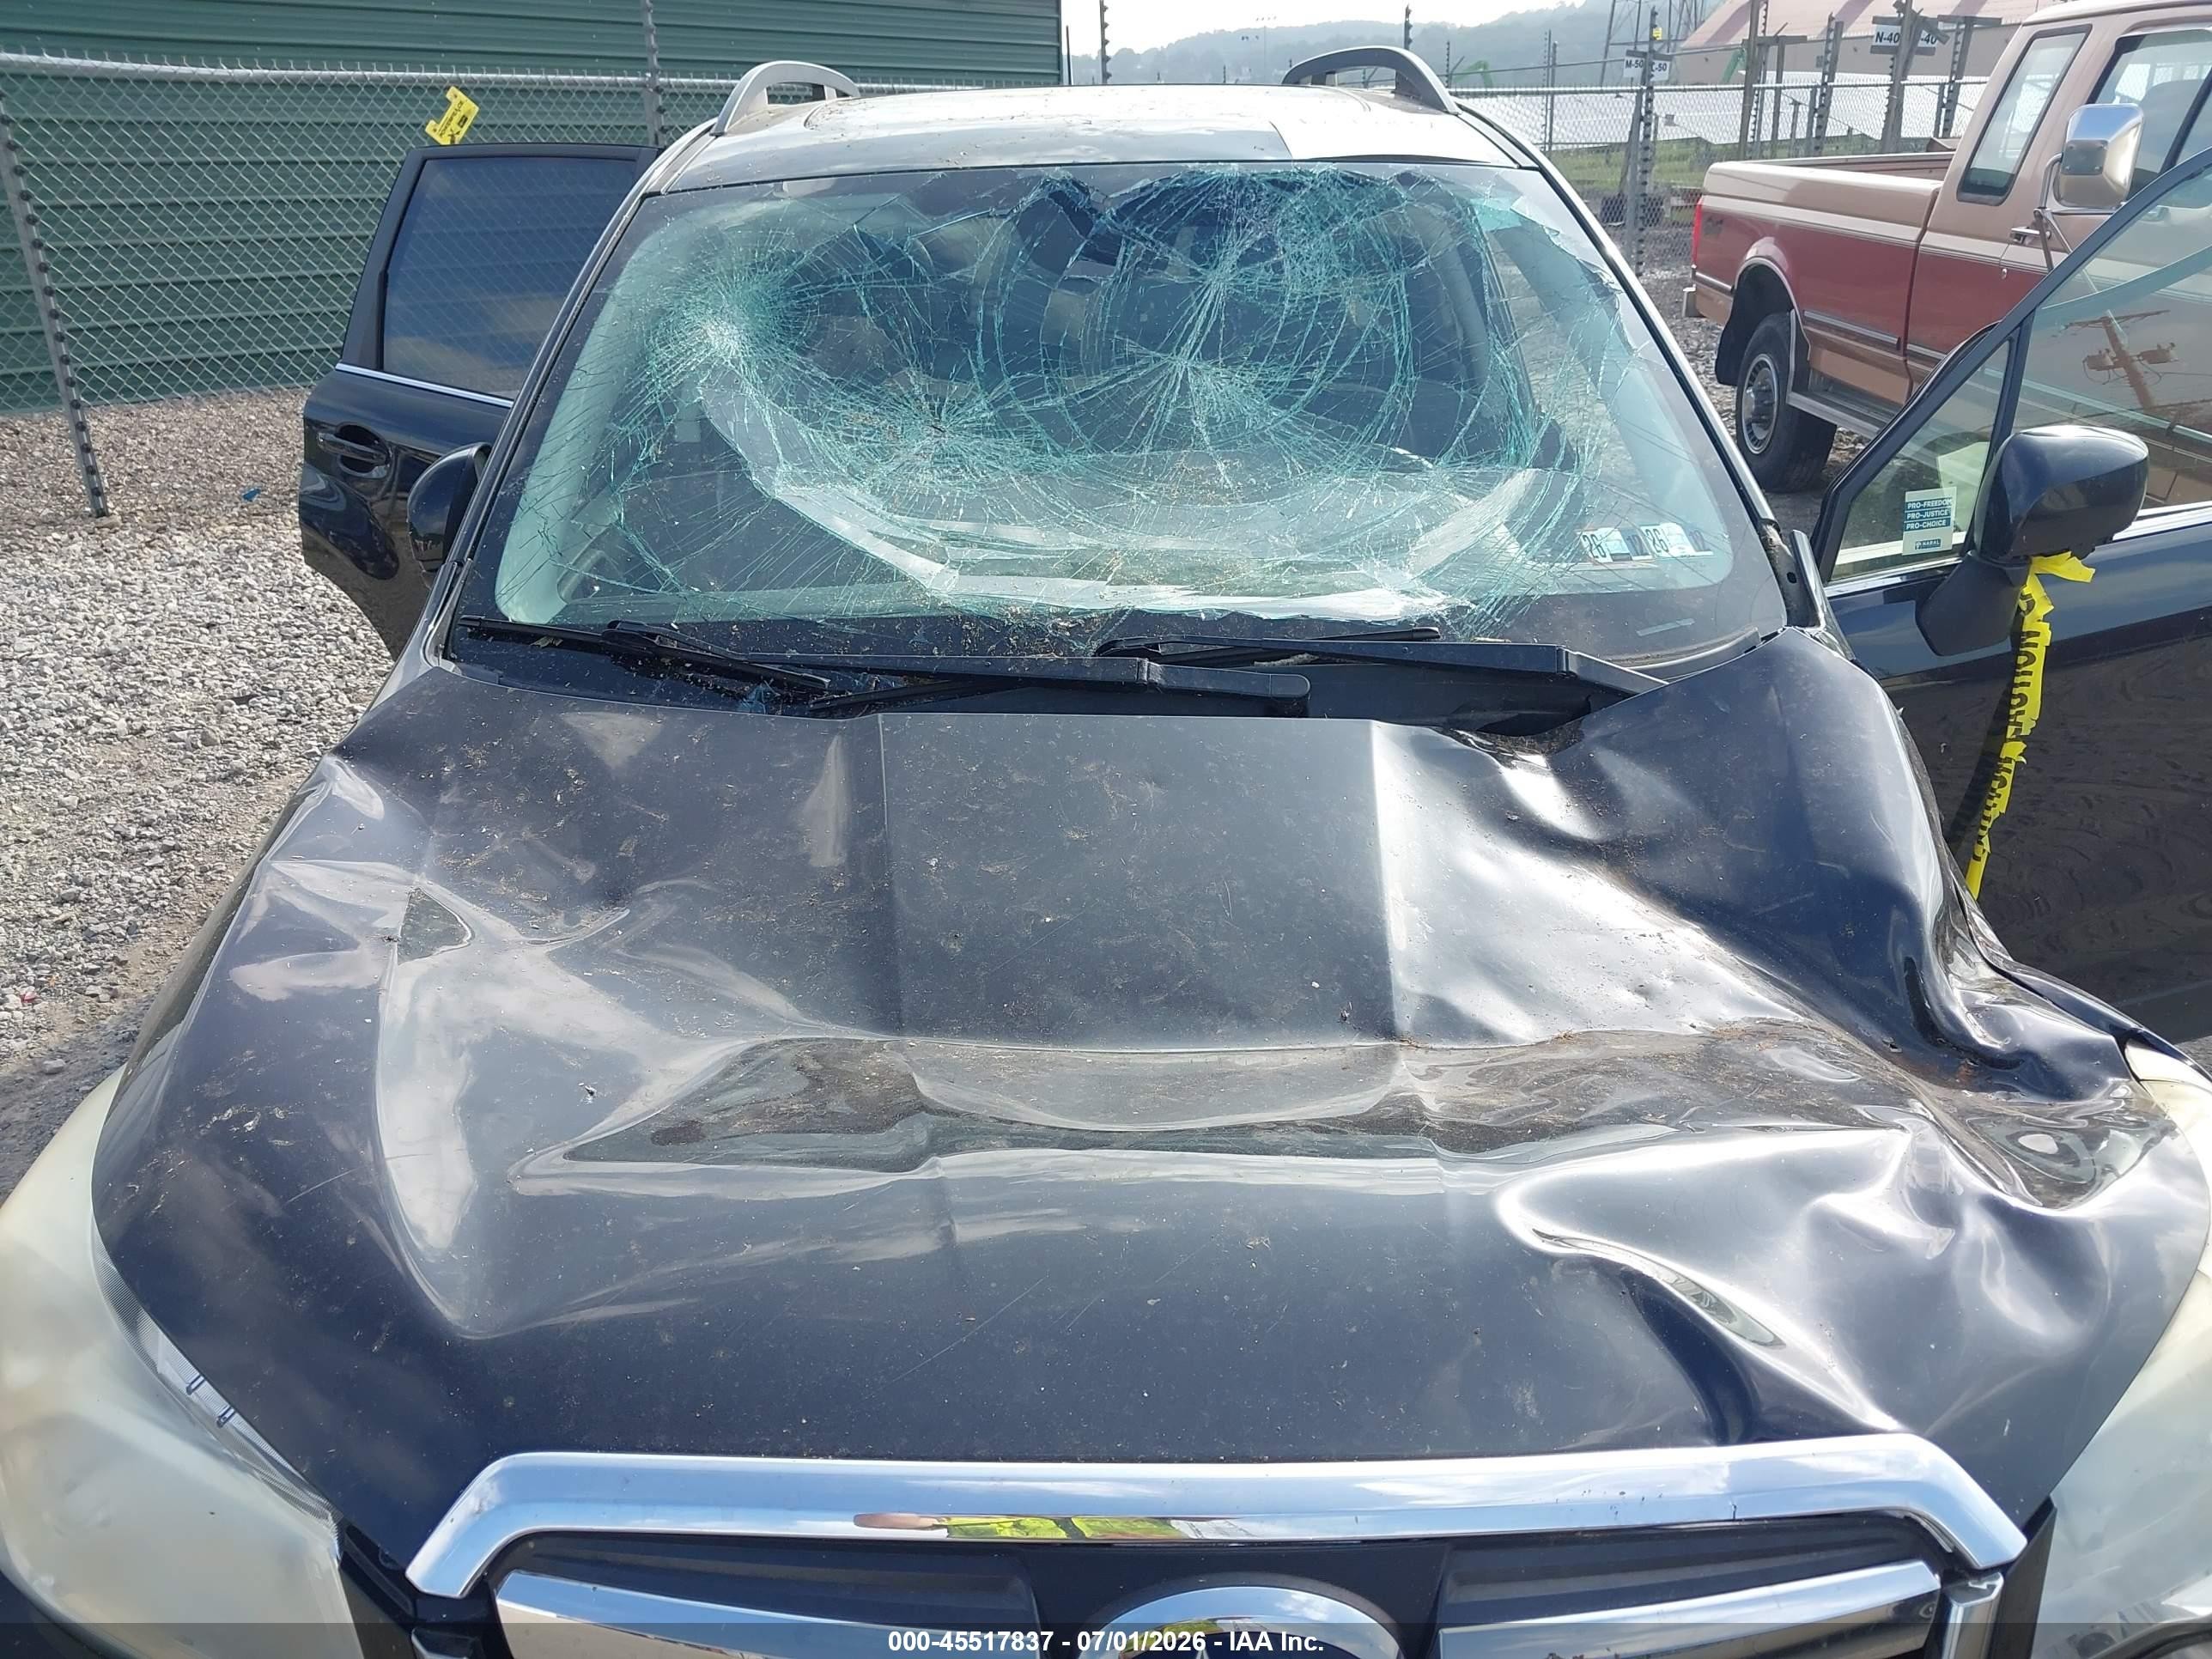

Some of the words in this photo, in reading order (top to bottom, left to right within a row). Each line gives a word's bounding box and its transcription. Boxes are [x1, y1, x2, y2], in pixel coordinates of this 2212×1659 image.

[1875, 31, 1900, 44] N-40
[1907, 498, 1953, 509] PRO-FREEDOM
[1906, 509, 1949, 520] PRO-JUSTICE
[1906, 520, 1947, 530] PRO-CHOICE
[1582, 533, 1607, 558] 26
[1644, 528, 1669, 553] 26
